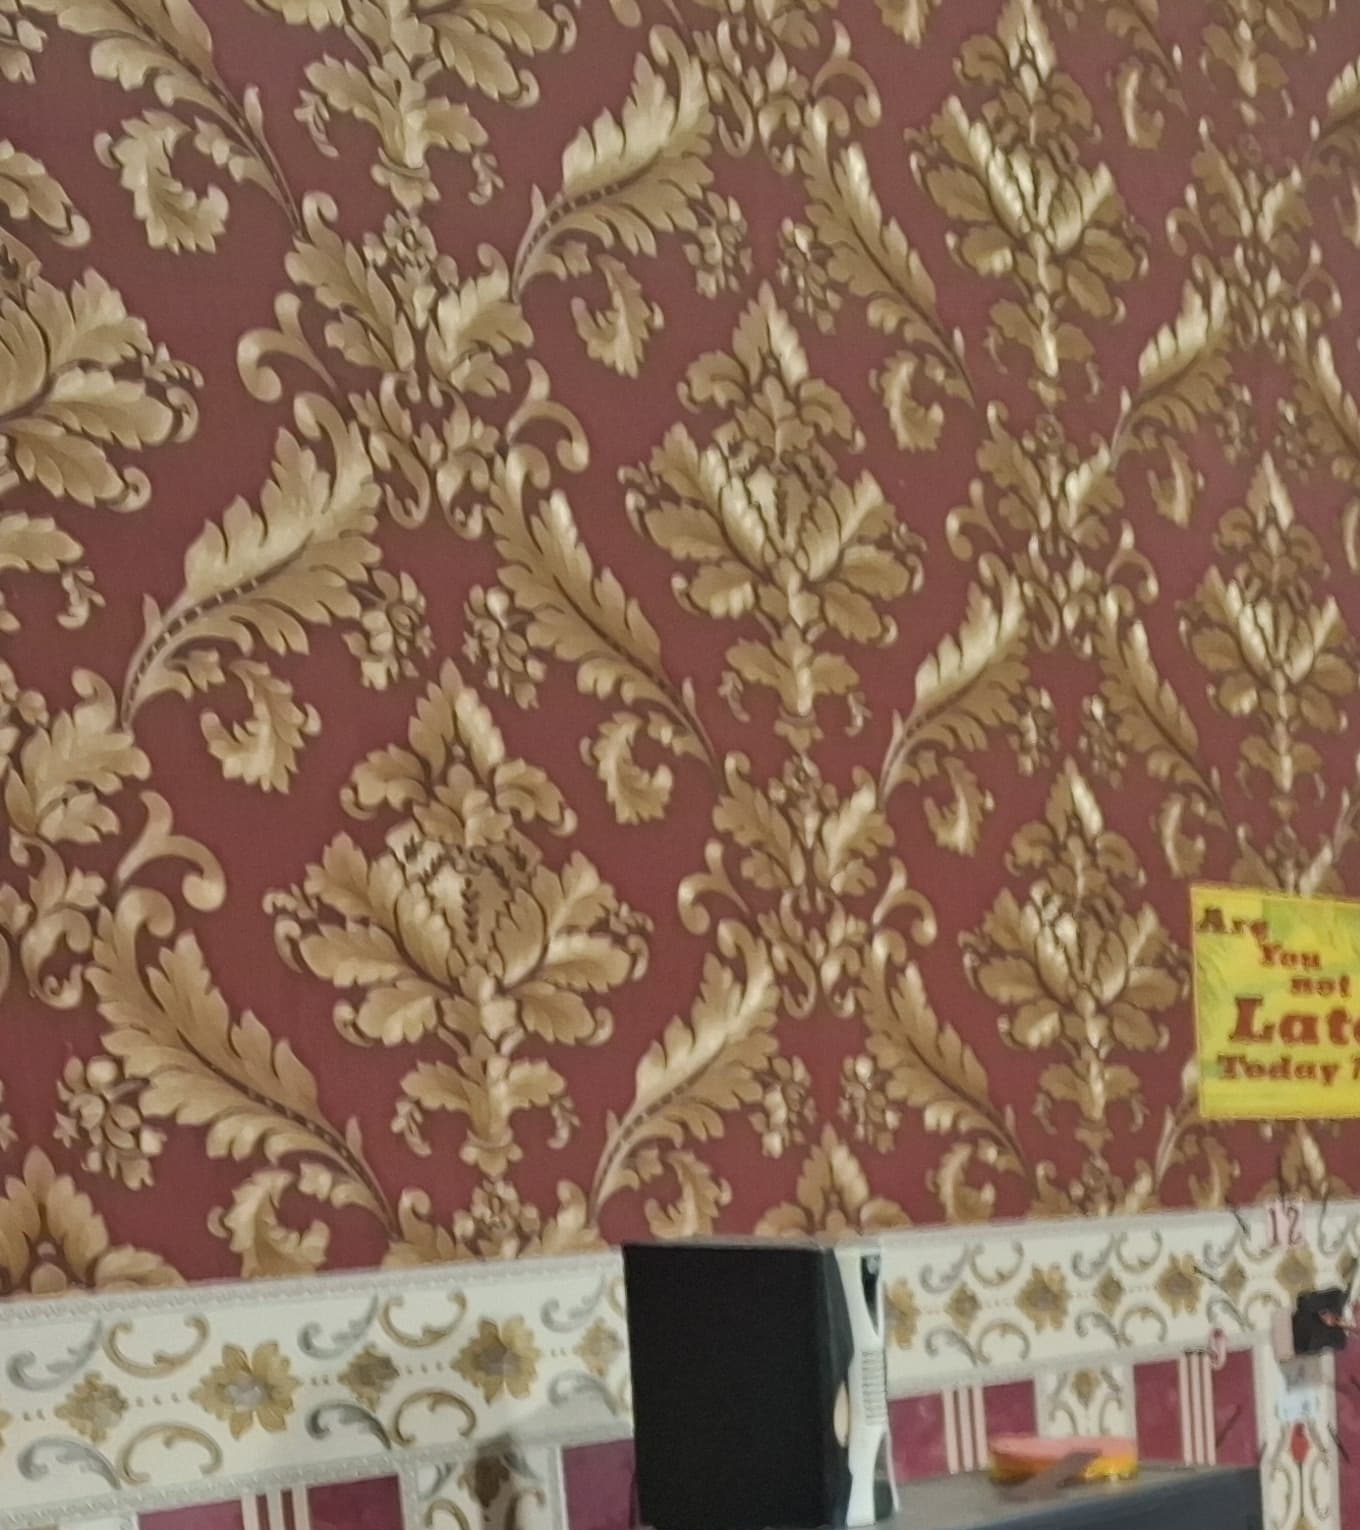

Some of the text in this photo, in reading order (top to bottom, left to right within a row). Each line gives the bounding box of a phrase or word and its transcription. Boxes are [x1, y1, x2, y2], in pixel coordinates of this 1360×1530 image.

[1197, 907, 1270, 941] Are
[1260, 943, 1322, 970] You
[1290, 975, 1351, 997] not
[1217, 1053, 1340, 1087] Today
[1267, 1206, 1303, 1248] 12
